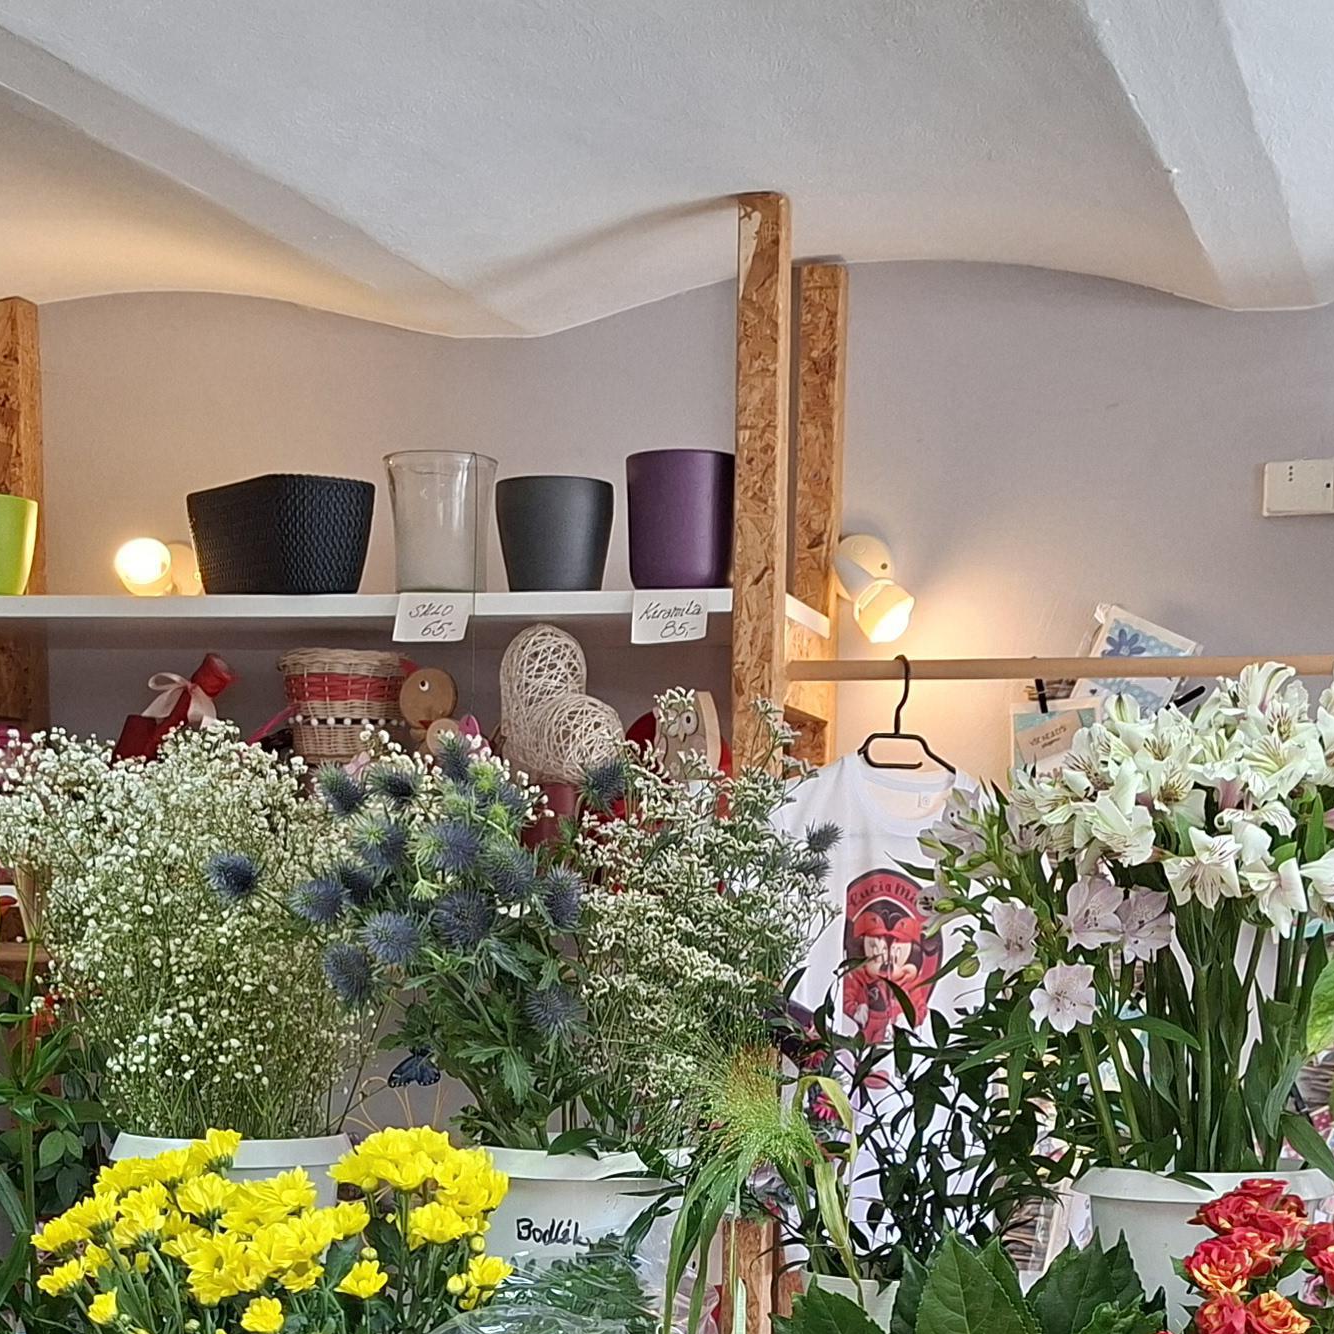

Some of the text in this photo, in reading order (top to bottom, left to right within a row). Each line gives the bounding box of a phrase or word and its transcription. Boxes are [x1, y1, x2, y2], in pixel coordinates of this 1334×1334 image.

[409, 603, 454, 618] SKLO
[421, 620, 456, 639] 65,-
[660, 620, 697, 639] 85,-
